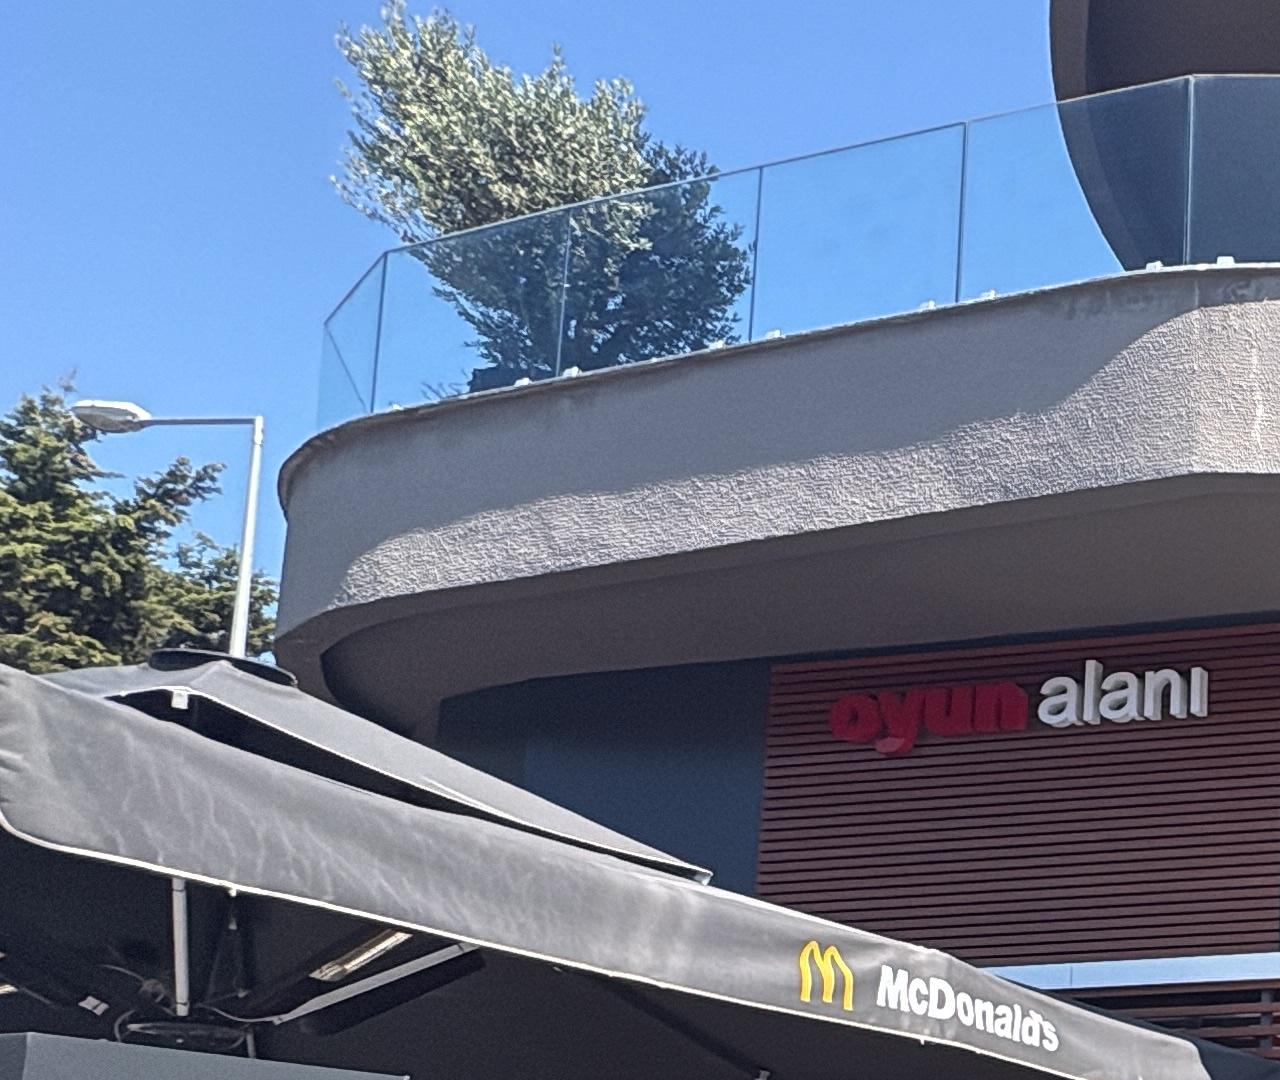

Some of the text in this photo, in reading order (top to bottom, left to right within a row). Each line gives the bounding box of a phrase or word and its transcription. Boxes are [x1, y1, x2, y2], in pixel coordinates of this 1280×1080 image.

[828, 659, 1209, 756] oyun alanı
[876, 964, 1060, 1052] McDonald's
